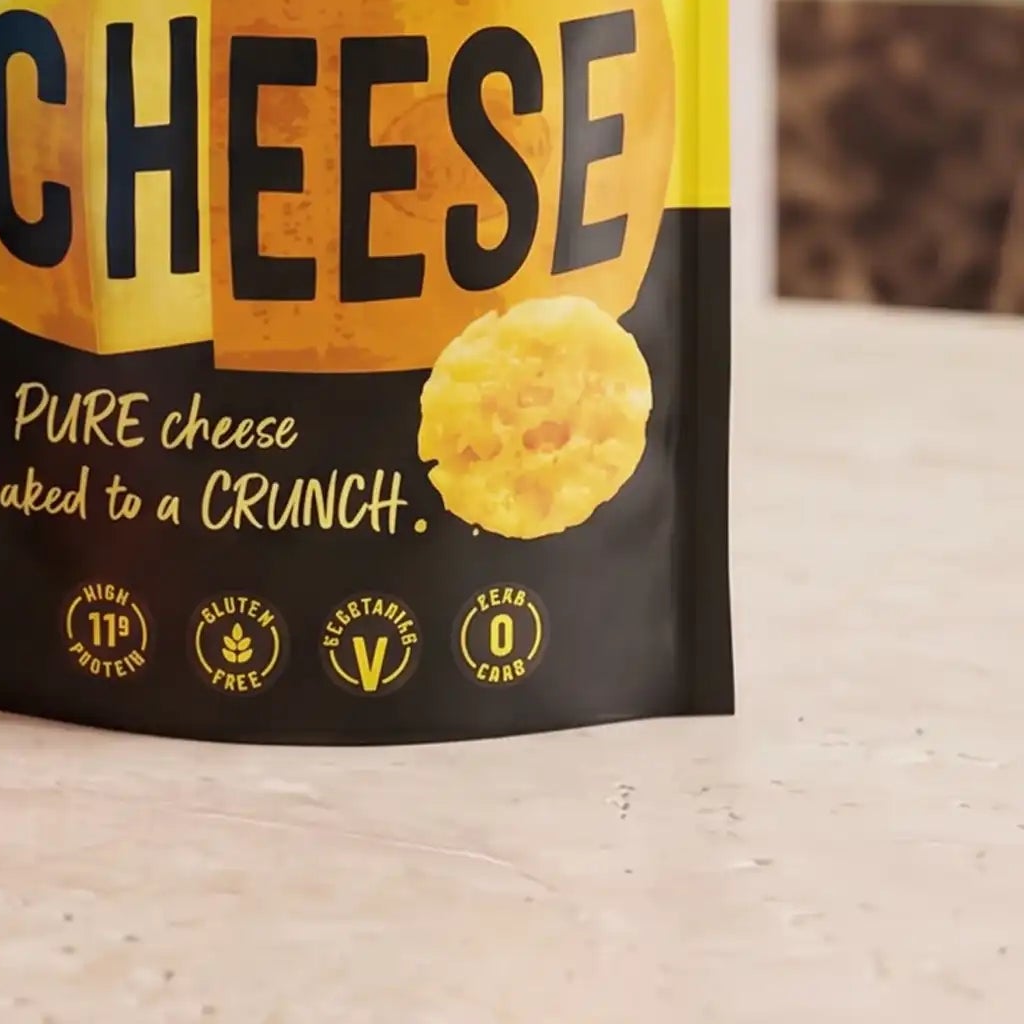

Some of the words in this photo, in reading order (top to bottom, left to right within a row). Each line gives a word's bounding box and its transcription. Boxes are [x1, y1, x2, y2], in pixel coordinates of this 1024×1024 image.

[14, 381, 149, 448] PURE
[160, 392, 299, 450] cheese
[105, 473, 142, 521] to
[156, 494, 180, 525] a
[82, 583, 130, 606] HIGH
[212, 668, 262, 692] FREE
[351, 636, 389, 692] V
[476, 658, 526, 683] CARB
